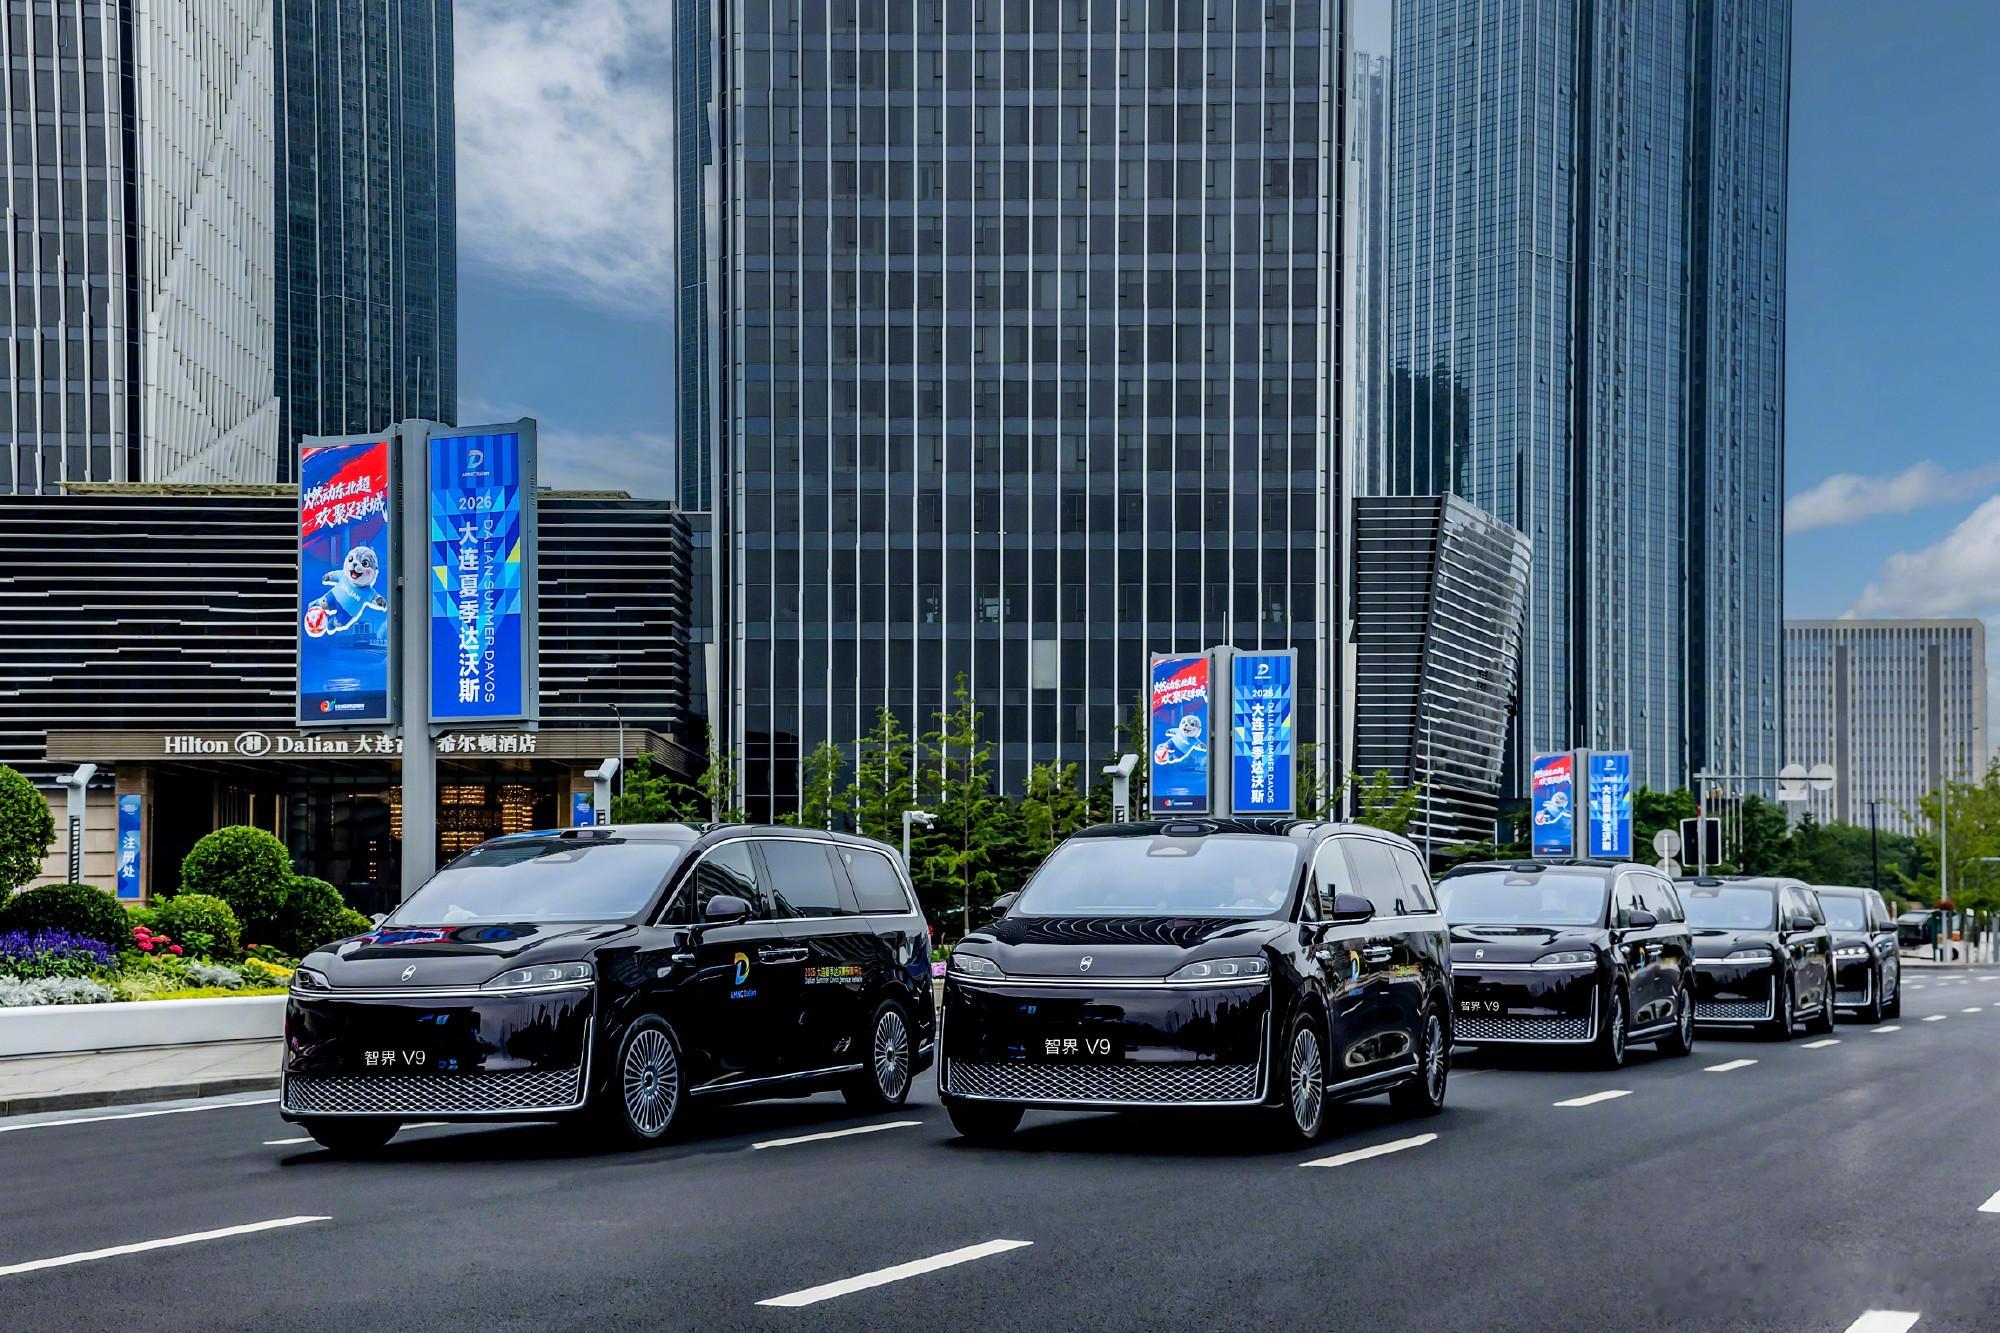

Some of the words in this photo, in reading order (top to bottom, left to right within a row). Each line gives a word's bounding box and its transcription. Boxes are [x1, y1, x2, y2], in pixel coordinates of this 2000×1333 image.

[458, 496, 492, 510] 2026
[483, 520, 494, 576] DALIAN
[458, 521, 480, 703] 大连夏季达沃斯
[484, 580, 495, 646] SUMMER
[484, 650, 495, 702] DAVOS
[164, 736, 229, 753] Hilton
[276, 736, 349, 753] Dalian
[1251, 702, 1264, 804] 大连夏季达沃斯
[122, 836, 136, 878] 注册处
[1460, 1000, 1481, 1011] 智界
[1484, 1001, 1500, 1011] V9
[364, 1050, 396, 1066] 智界
[402, 1050, 426, 1065] V9
[1044, 1037, 1079, 1055] 智界
[1085, 1038, 1111, 1055] V9
